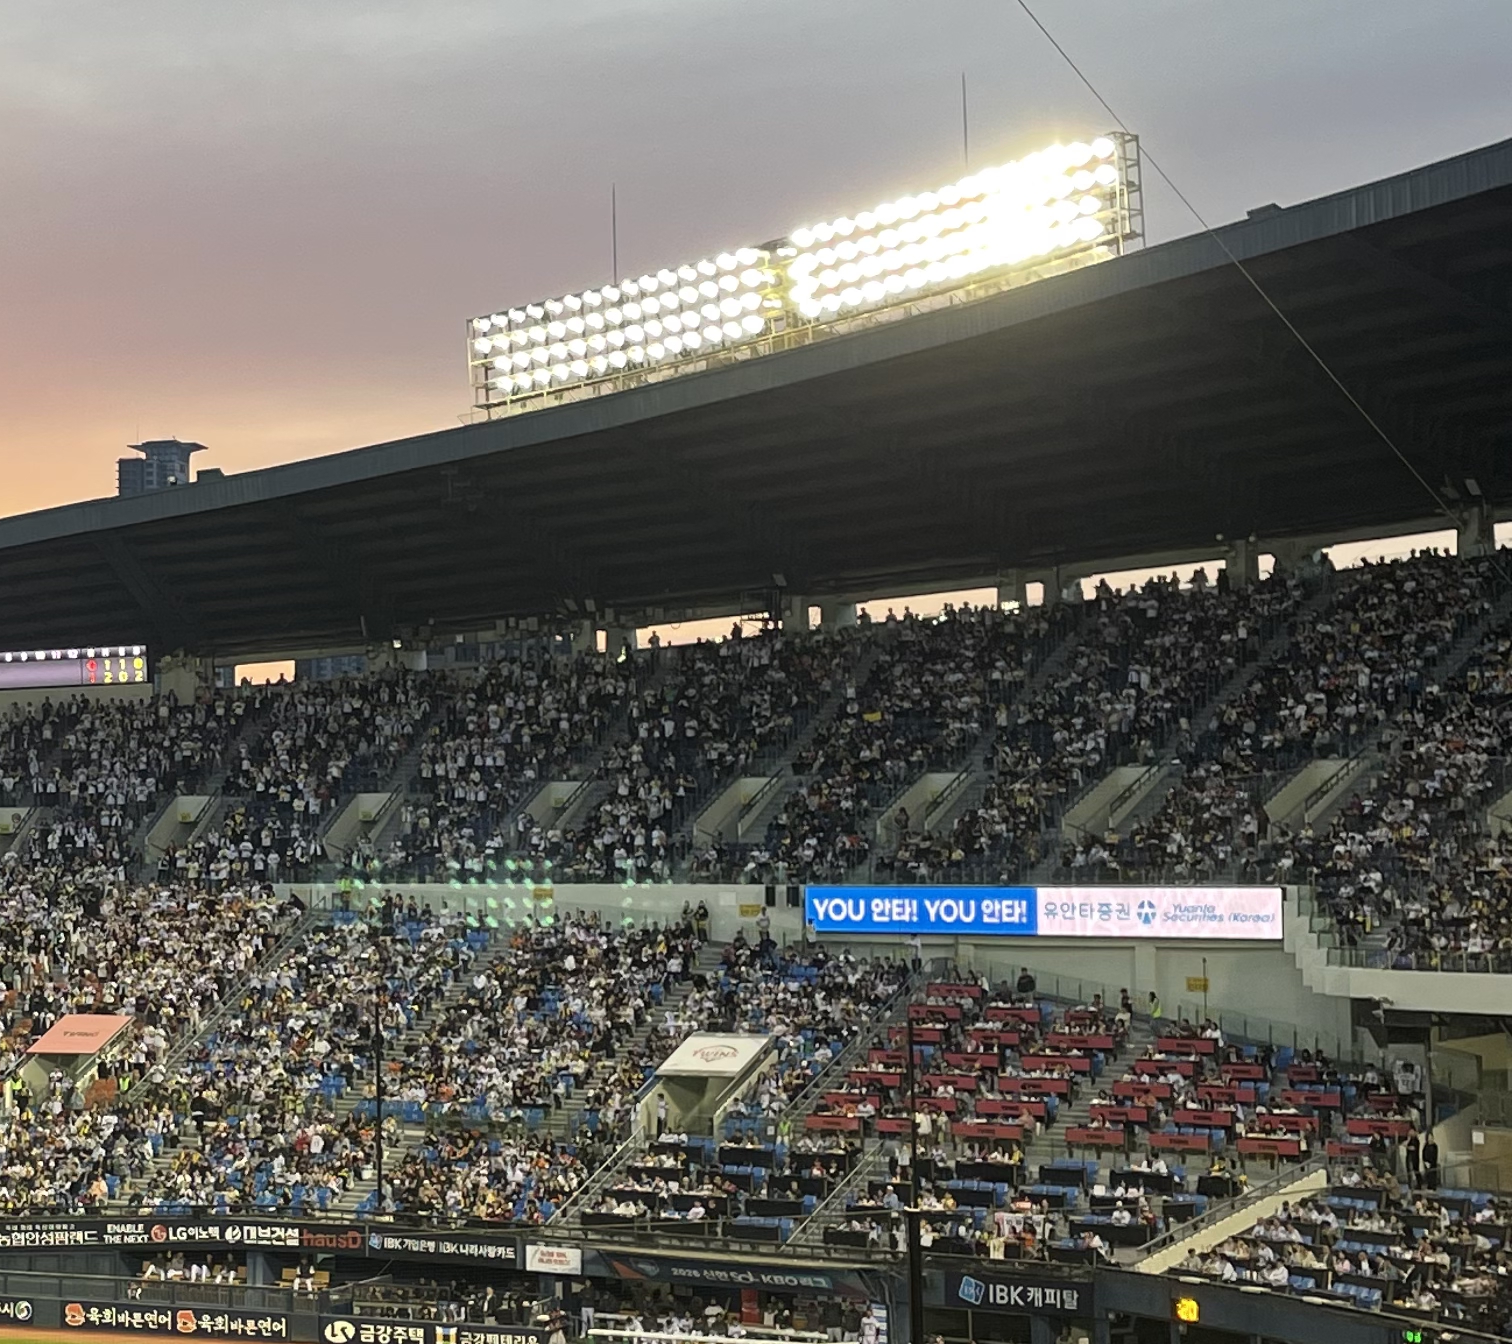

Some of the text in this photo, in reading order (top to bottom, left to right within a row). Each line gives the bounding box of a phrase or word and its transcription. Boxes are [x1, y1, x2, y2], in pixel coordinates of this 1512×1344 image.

[104, 659, 111, 671] 1
[119, 658, 126, 670] 1
[100, 671, 112, 683] 2
[134, 670, 143, 682] 2
[813, 897, 1027, 924] YOU 안타! YOU 안타!
[1043, 901, 1131, 921] 유안타증권
[1228, 912, 1275, 923] (Korea)
[106, 1223, 144, 1234] ENABLE
[168, 1226, 220, 1241] LG이노텍
[243, 1225, 300, 1246] 대보건설
[104, 1234, 150, 1244] THE NEXT
[302, 1228, 362, 1249] hausD
[760, 1273, 798, 1286] KBO
[86, 1306, 287, 1338] 육회바른연어 육회바른연어
